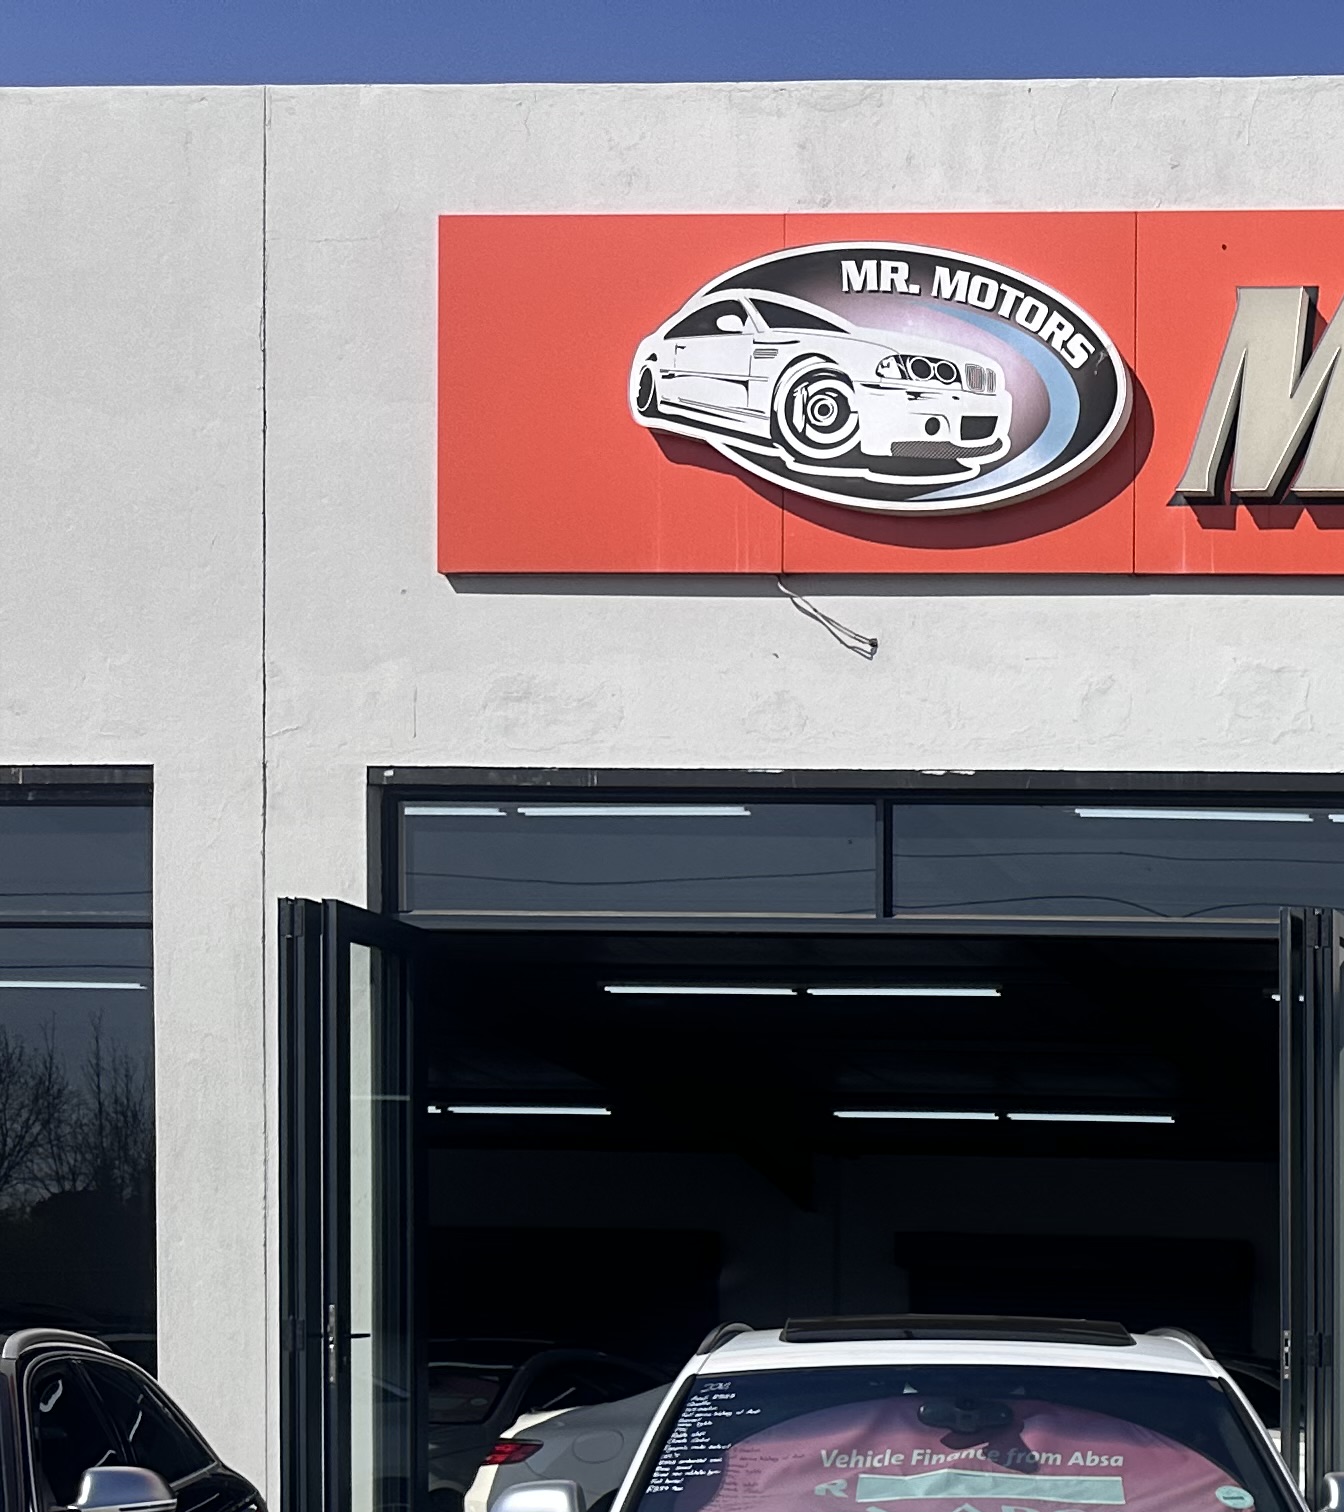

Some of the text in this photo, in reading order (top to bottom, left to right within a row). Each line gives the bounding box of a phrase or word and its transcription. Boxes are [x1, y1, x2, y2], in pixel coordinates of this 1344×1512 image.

[840, 259, 1097, 370] MR. MOTORS
[820, 1447, 1124, 1468] Vehicle Finance from Absa
